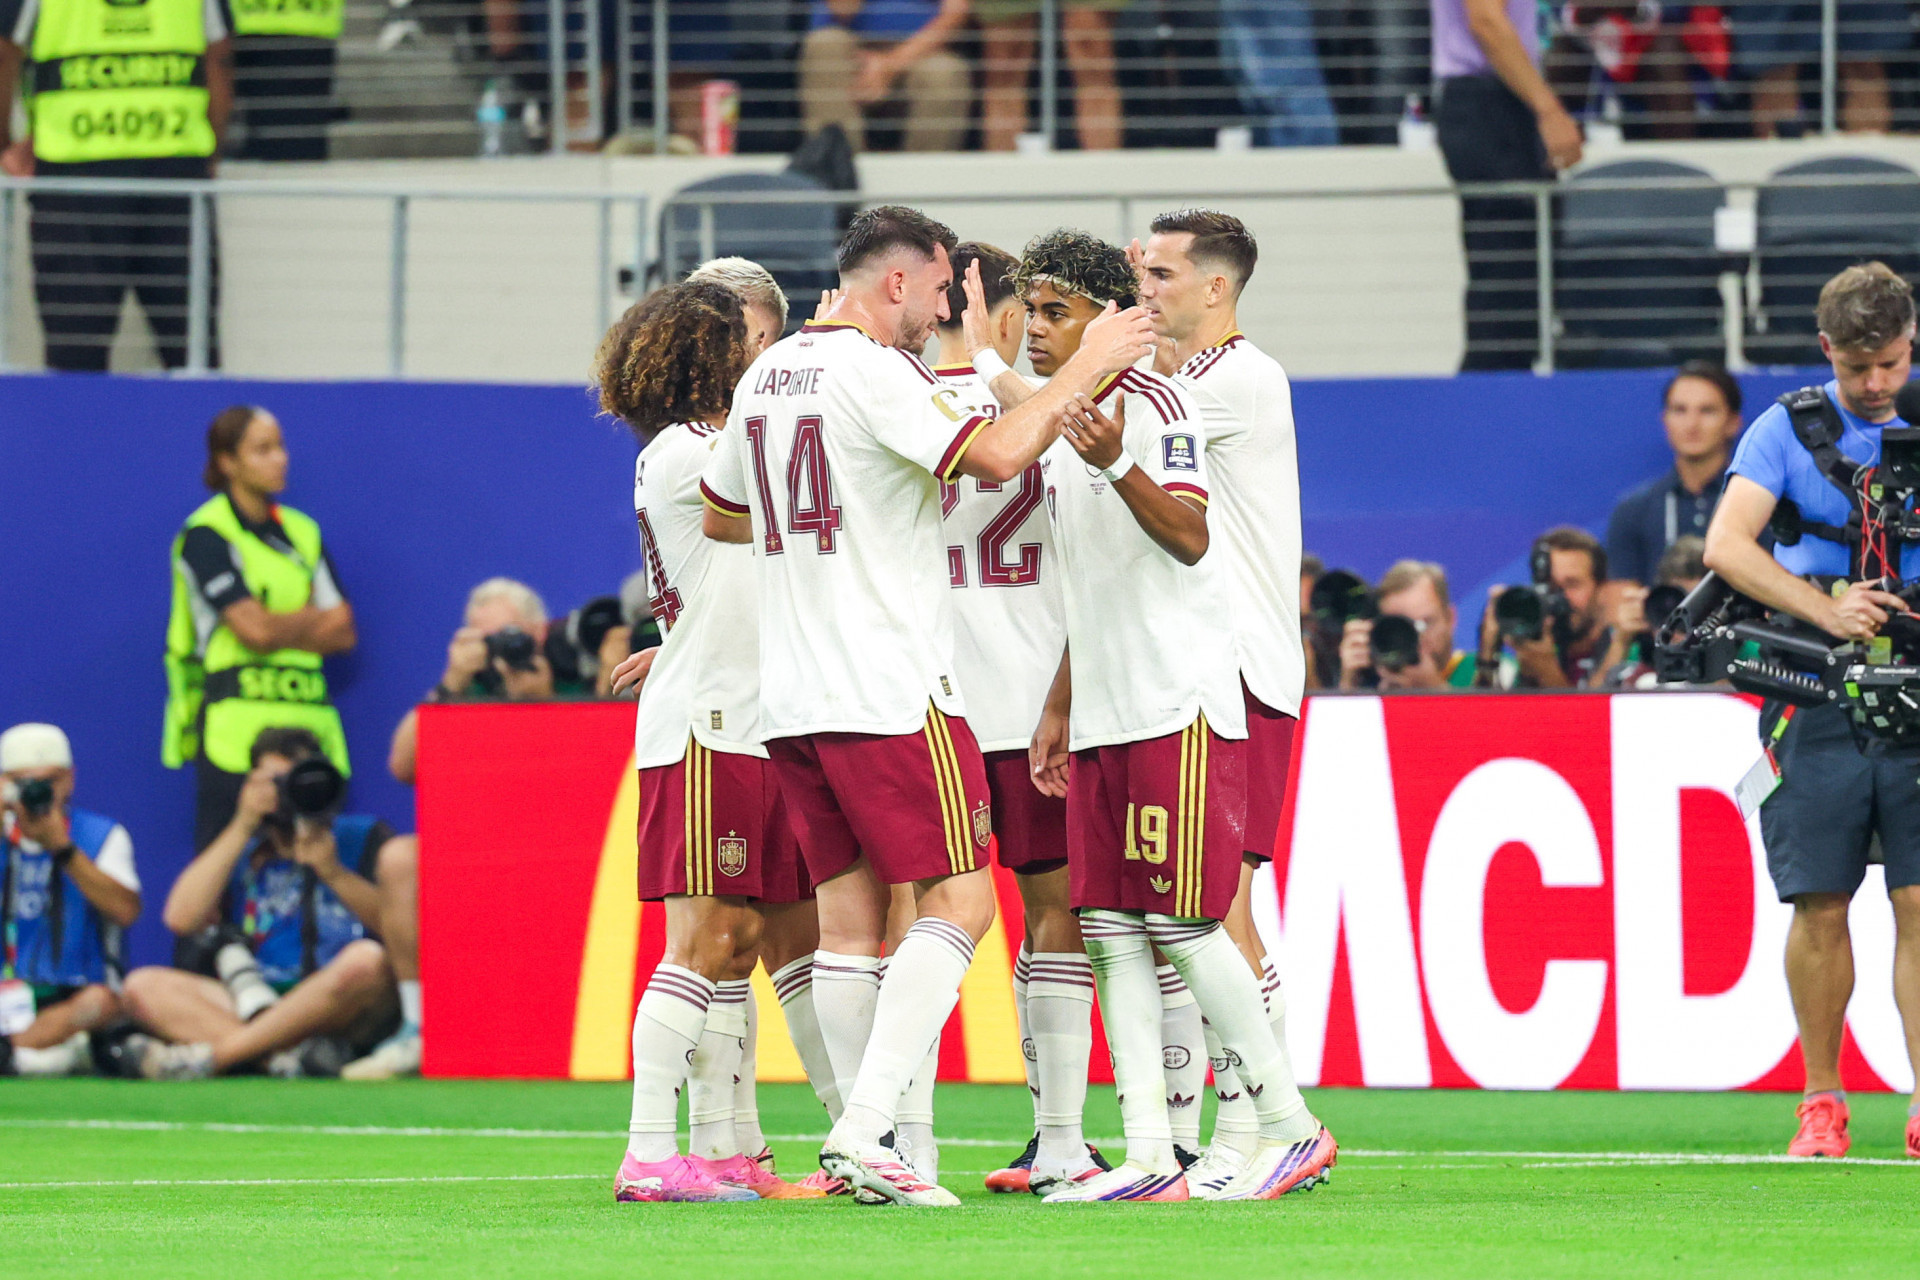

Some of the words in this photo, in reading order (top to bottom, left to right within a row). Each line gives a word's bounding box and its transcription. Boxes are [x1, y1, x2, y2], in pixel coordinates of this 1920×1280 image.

[60, 54, 197, 88] SECURITY
[71, 107, 189, 139] 04092
[754, 368, 824, 396] LAPORTE
[745, 415, 842, 556] 14
[1125, 802, 1168, 864] 19
